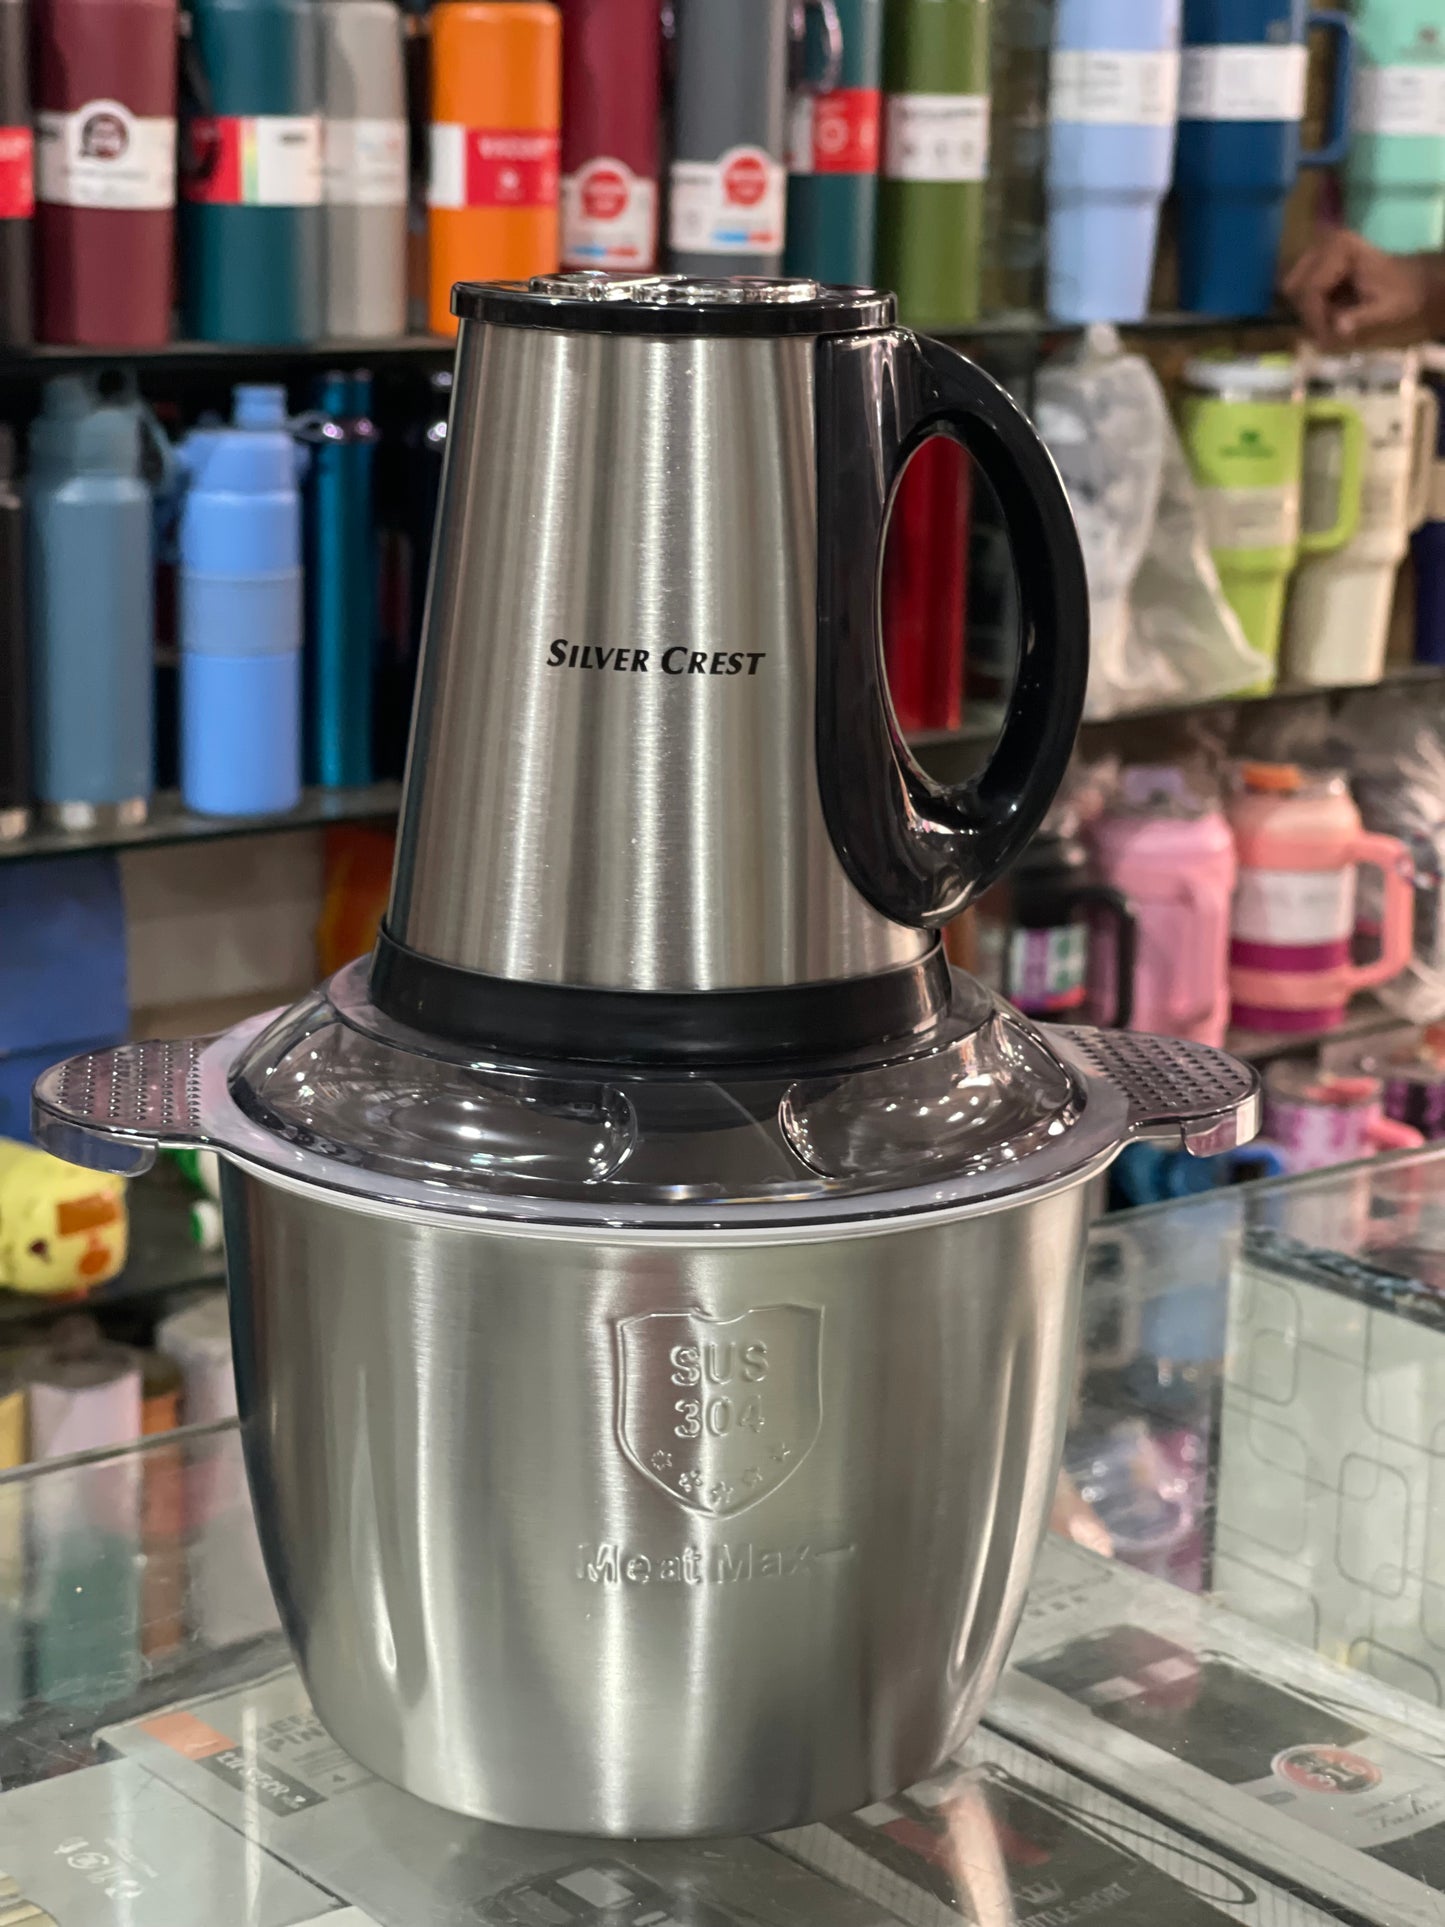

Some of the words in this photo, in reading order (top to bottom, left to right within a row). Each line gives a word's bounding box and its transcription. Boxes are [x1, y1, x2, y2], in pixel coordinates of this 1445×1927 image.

[546, 640, 649, 672] SILVER
[661, 646, 766, 675] CREST
[670, 1341, 769, 1386] SUS
[674, 1396, 765, 1438] 304
